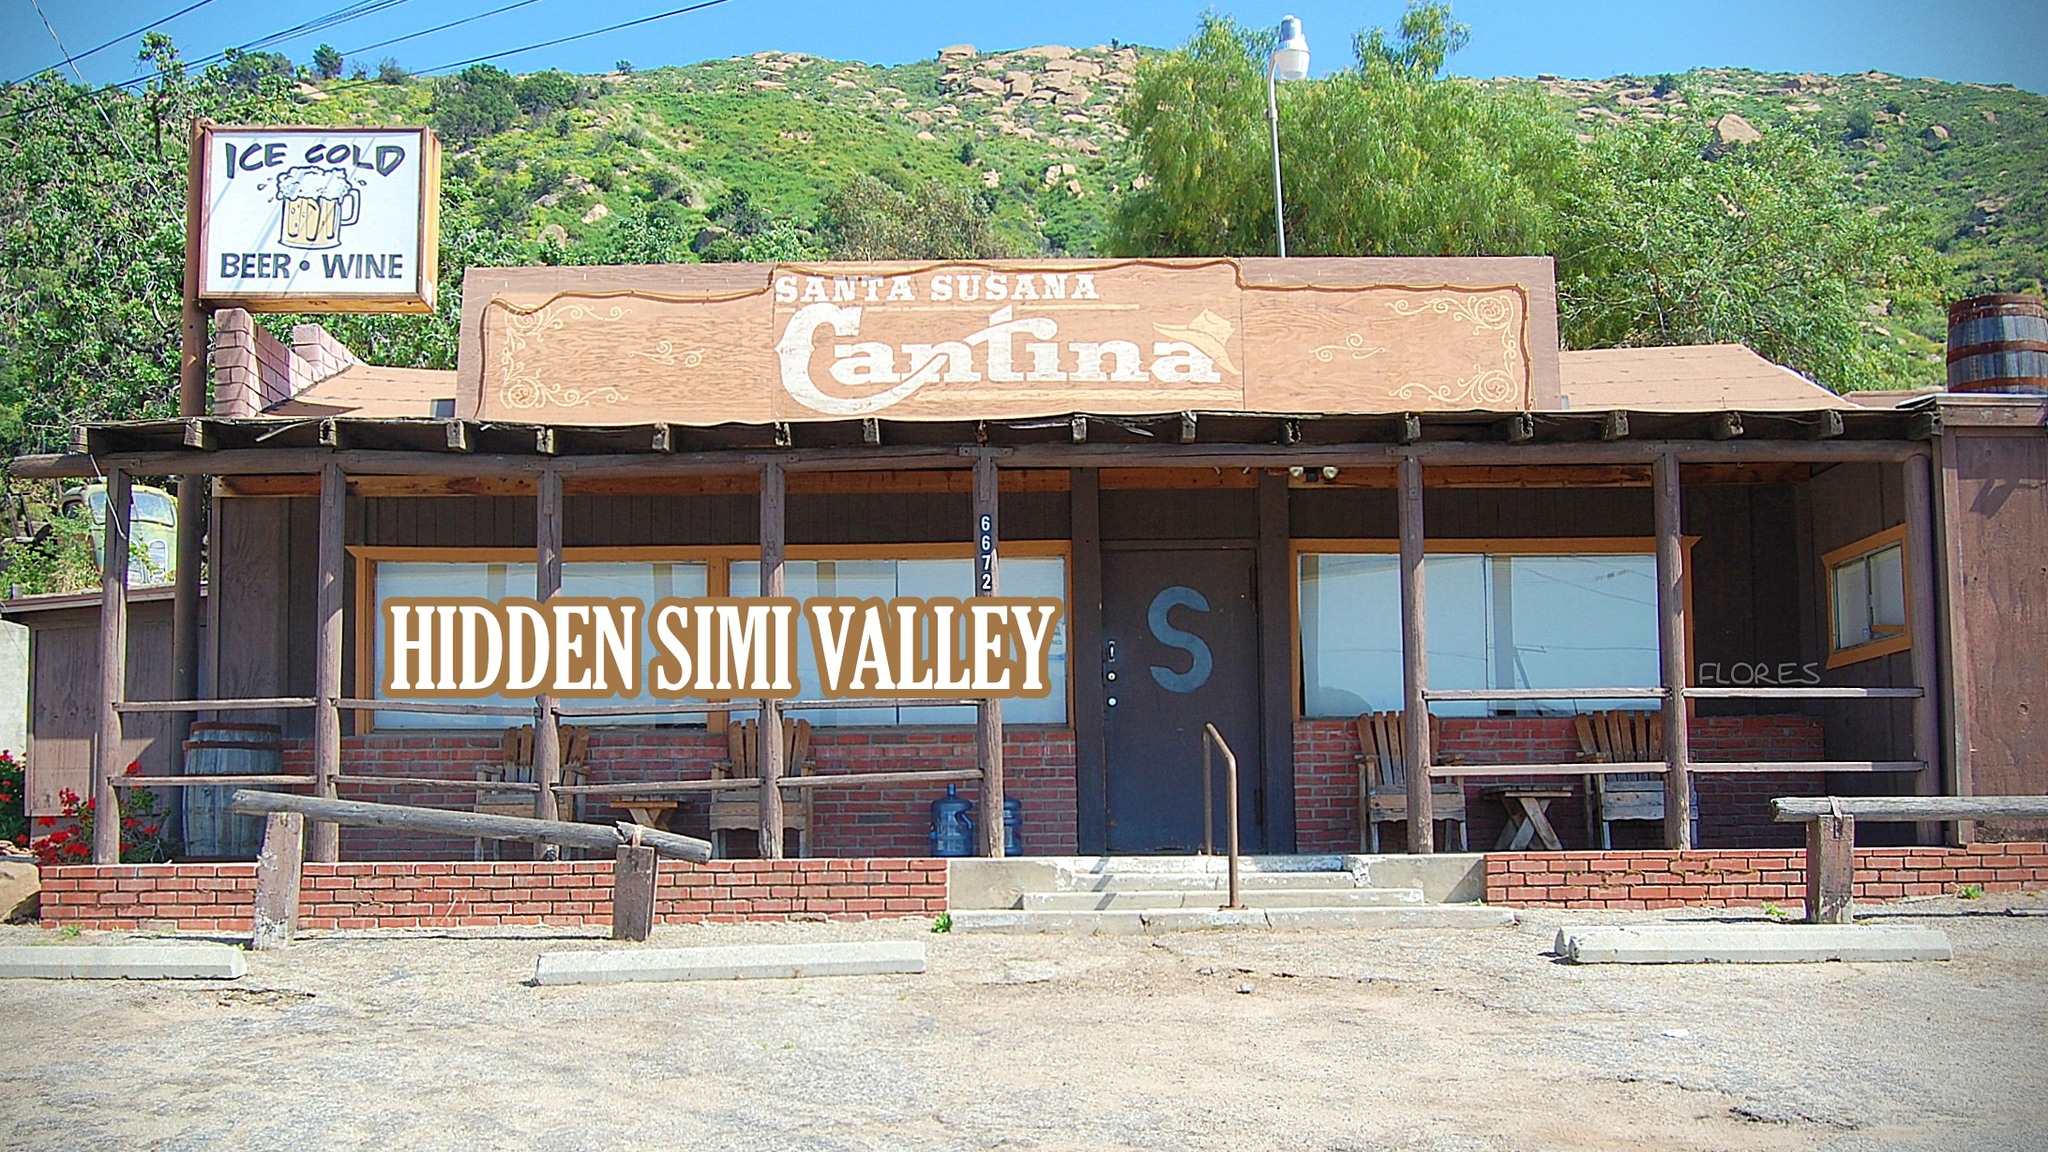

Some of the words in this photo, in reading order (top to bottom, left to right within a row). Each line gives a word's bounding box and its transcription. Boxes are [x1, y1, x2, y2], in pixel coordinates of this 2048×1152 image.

[225, 143, 287, 179] ICE
[304, 144, 406, 177] COLD
[220, 252, 291, 279] BEER
[322, 253, 403, 279] WINE
[775, 274, 915, 302] SANTA
[930, 273, 1100, 301] SUSANA
[774, 304, 1221, 415] Cantina
[980, 515, 993, 590] 6672
[1147, 586, 1213, 694] S
